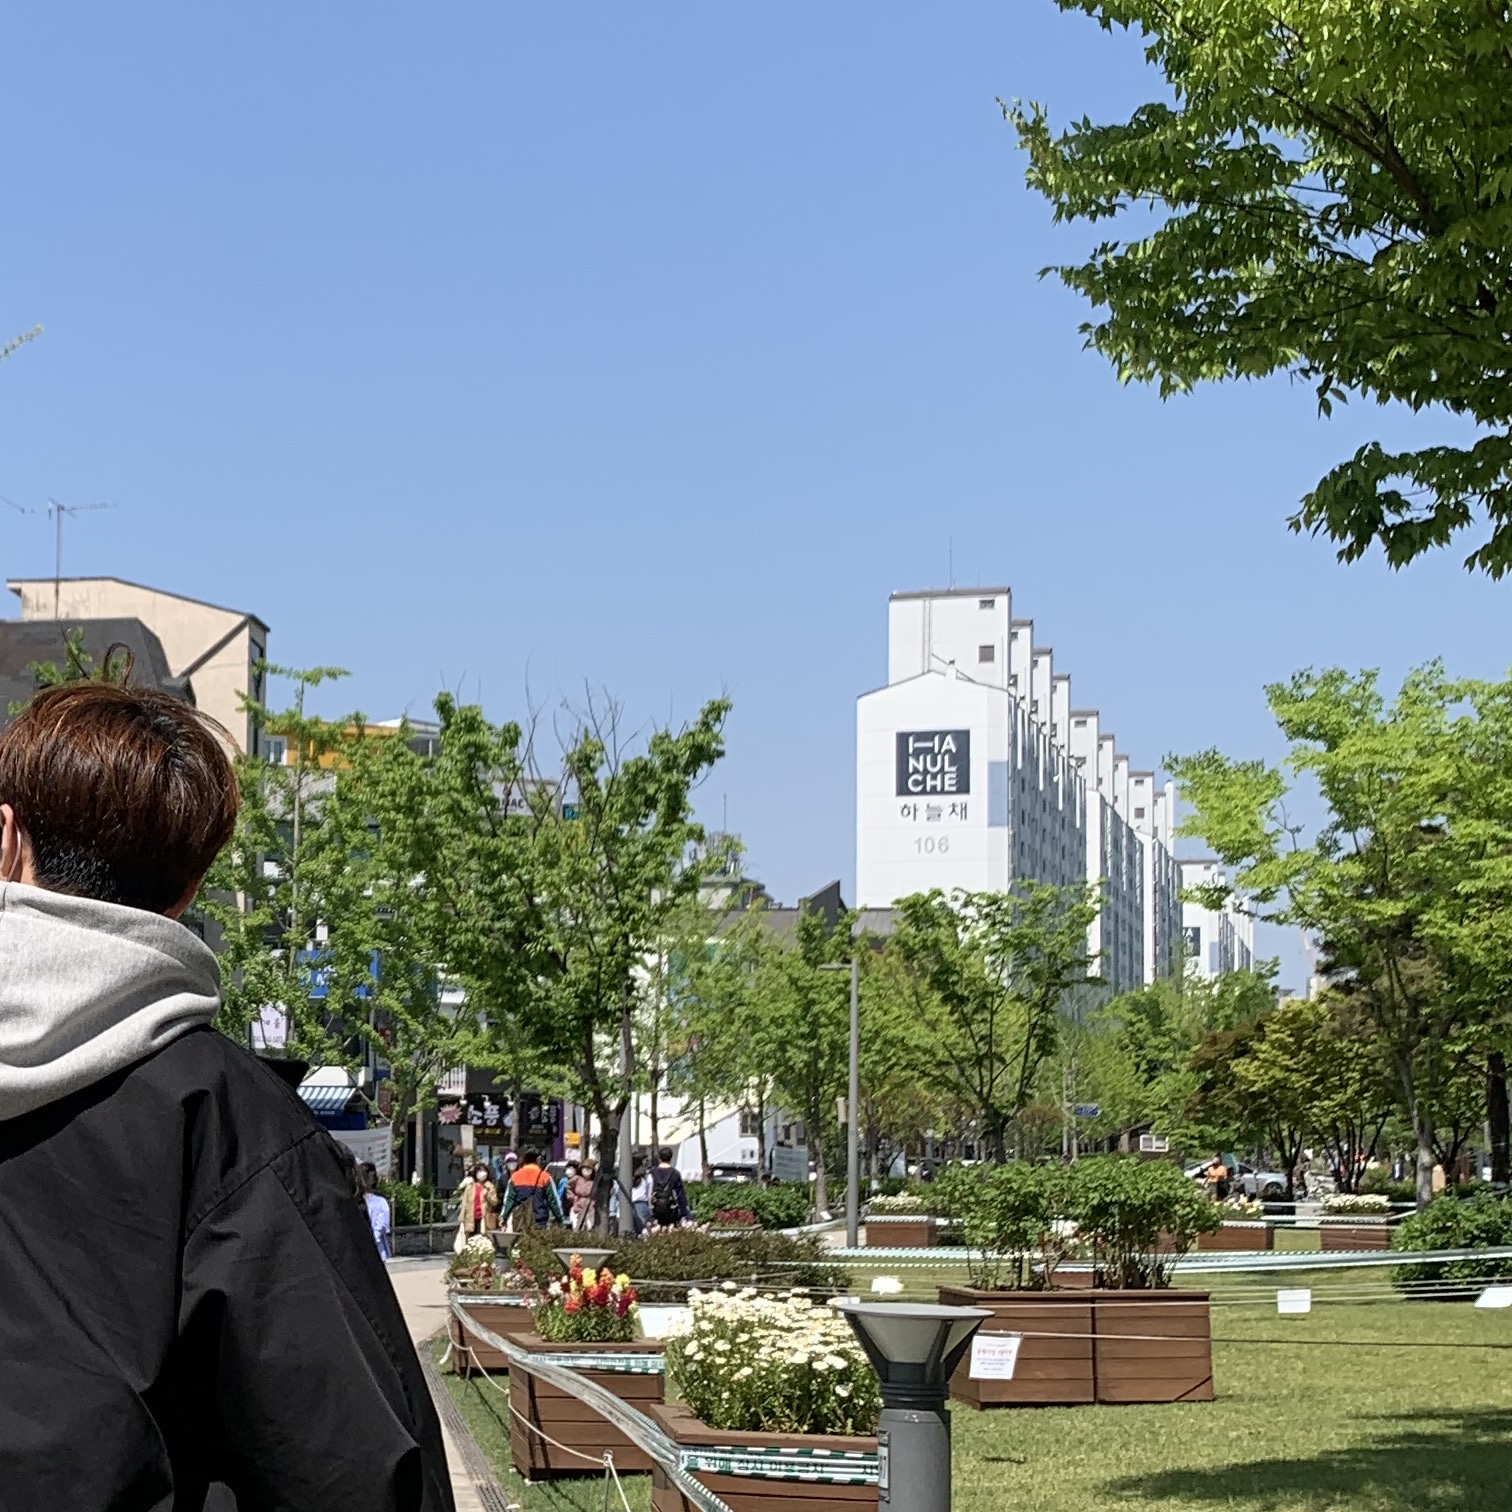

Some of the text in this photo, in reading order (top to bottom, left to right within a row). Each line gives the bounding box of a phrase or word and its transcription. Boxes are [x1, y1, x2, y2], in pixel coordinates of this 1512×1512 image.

[907, 773, 958, 792] CHE
[900, 802, 968, 821] 하늘채
[914, 836, 949, 854] 106
